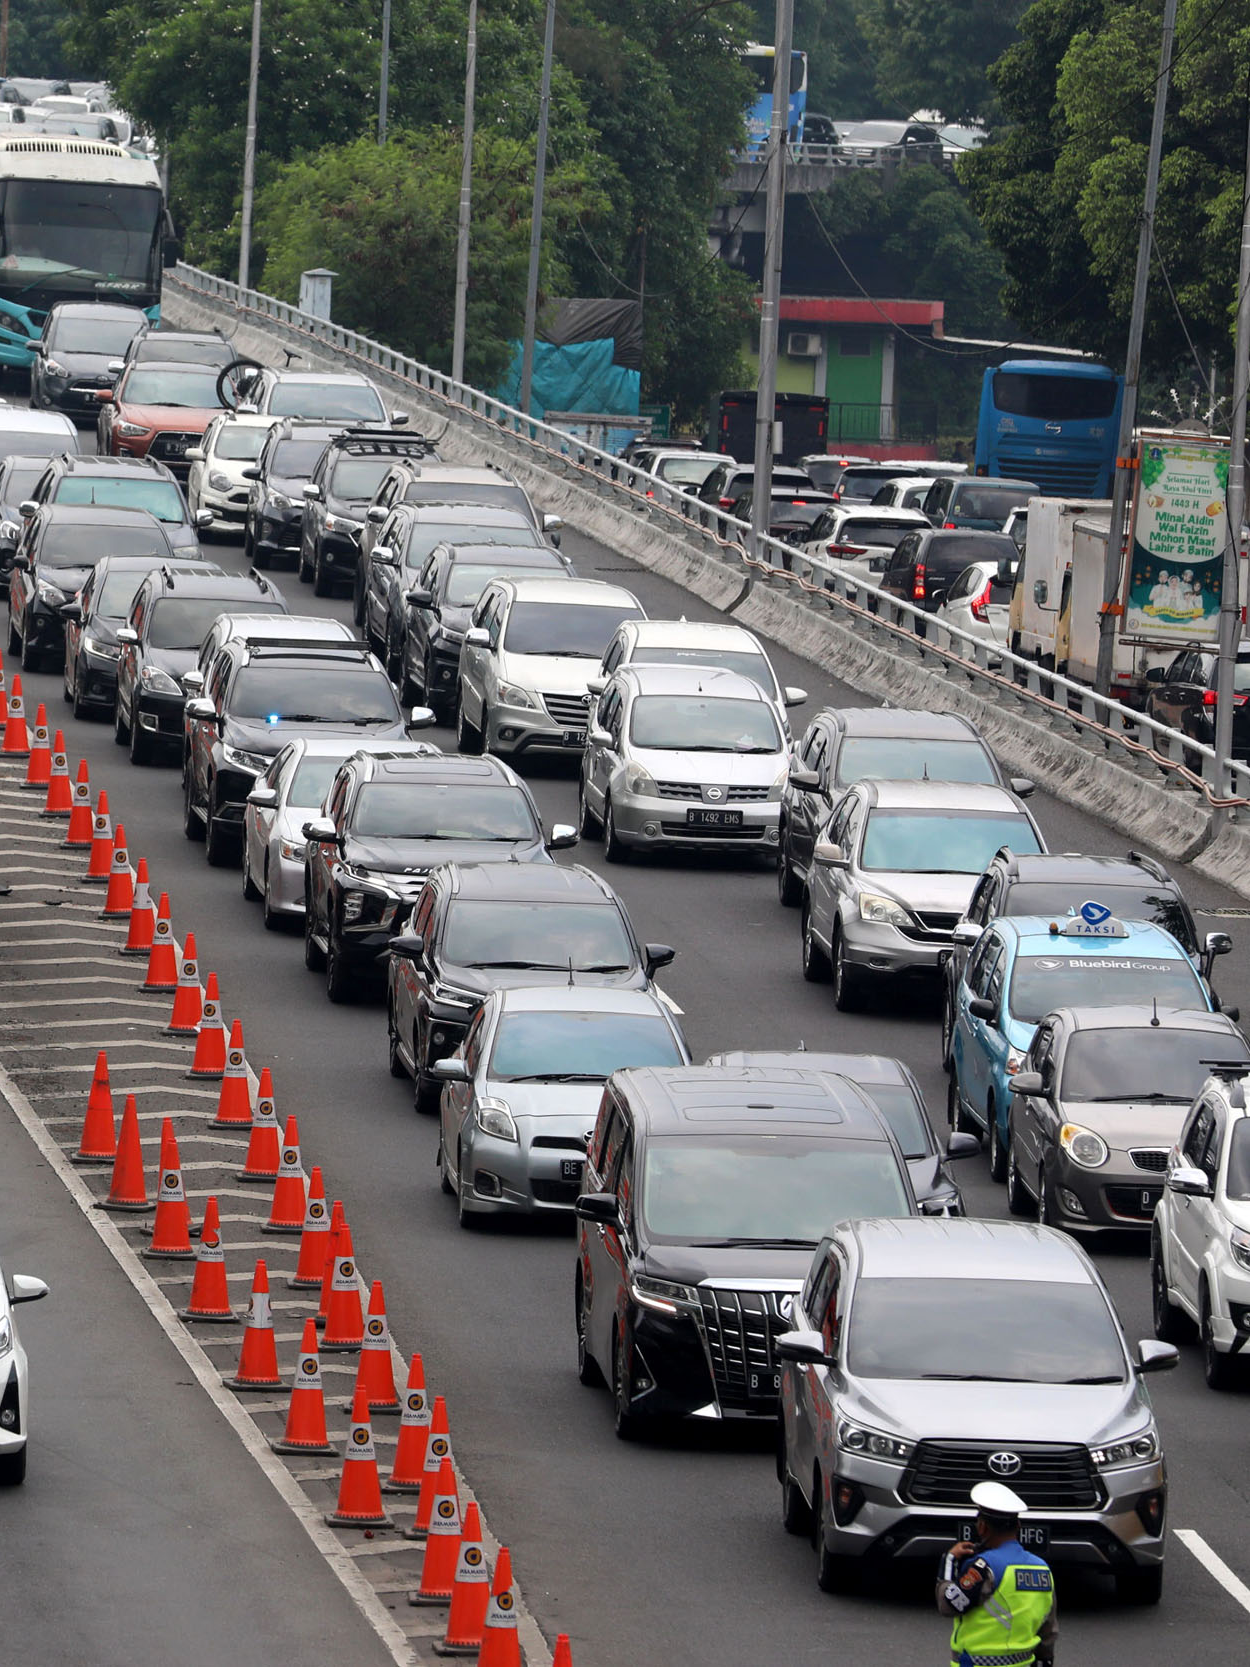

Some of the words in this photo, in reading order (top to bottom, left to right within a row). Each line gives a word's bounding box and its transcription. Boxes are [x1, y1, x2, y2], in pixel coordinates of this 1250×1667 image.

[1171, 499, 1190, 508] 1443
[1192, 500, 1199, 509] H
[1155, 511, 1185, 523] Minal
[1187, 514, 1214, 526] Aidin
[1159, 522, 1177, 533] Wal
[1180, 524, 1209, 536] Faizin
[1150, 531, 1185, 544] Mohon
[1188, 535, 1216, 547] Maaf
[1149, 542, 1174, 553] Lahir
[1177, 545, 1185, 553] &
[1188, 546, 1214, 557] Batin
[689, 812, 695, 822] B
[701, 812, 719, 823] 1492
[724, 813, 740, 824] EMS
[1076, 925, 1115, 934] TAKSI
[1069, 959, 1131, 969] Bluebird
[1132, 962, 1171, 972] Group
[564, 1162, 577, 1175] BE
[751, 1374, 759, 1388] B
[963, 1526, 971, 1541] B
[1020, 1529, 1044, 1544] HFG
[1017, 1572, 1051, 1588] POLISI
